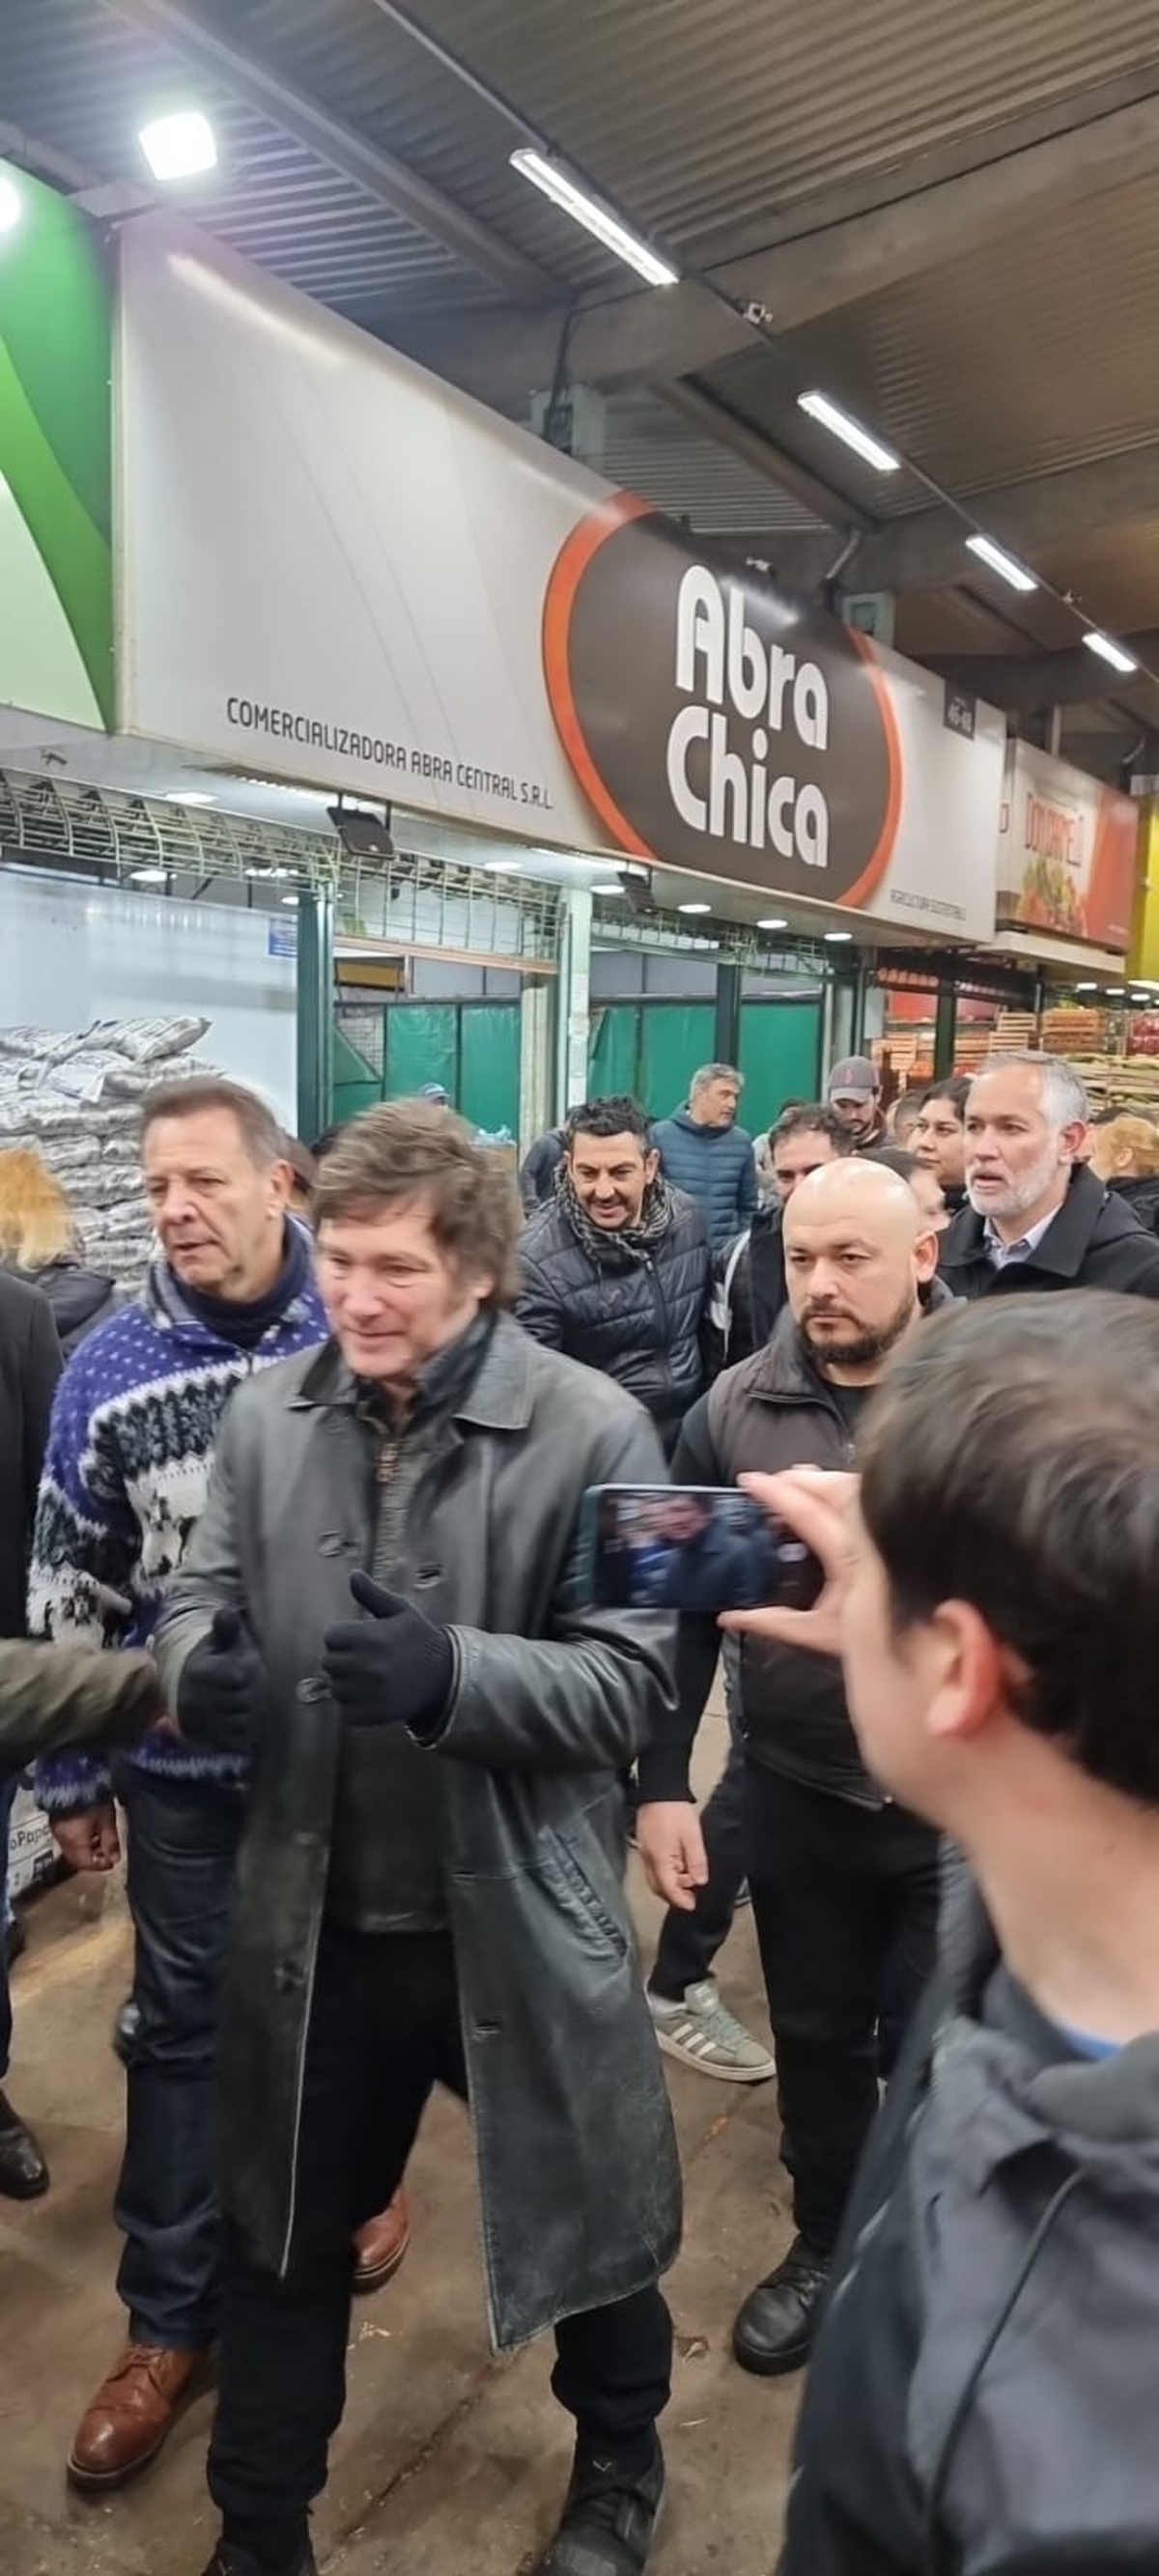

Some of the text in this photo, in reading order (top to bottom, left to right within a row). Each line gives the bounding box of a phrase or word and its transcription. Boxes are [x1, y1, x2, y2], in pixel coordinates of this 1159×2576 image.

[675, 564, 829, 751] Abra
[226, 696, 554, 810] COMERCIALIZADORA ABRA CENTRAL S.R.L.
[666, 704, 829, 869] Chica
